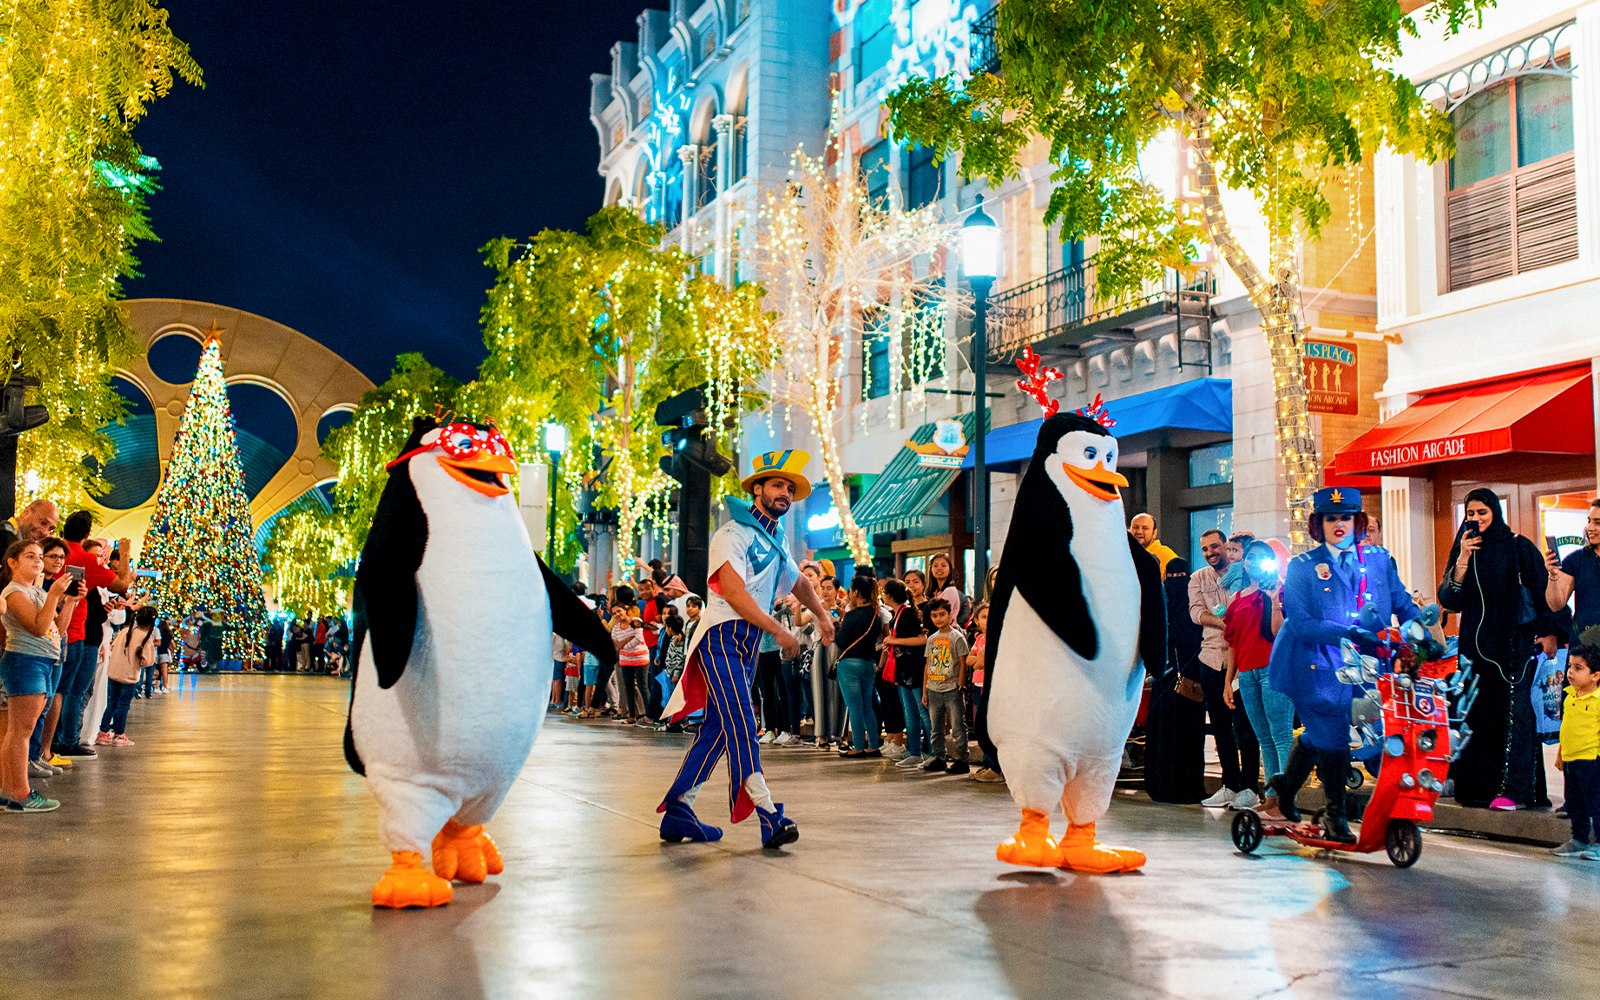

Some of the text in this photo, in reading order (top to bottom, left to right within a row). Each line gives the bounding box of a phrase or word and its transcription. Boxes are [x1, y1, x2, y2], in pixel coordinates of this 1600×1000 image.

[1321, 344, 1351, 365] PLACE
[1371, 438, 1466, 467] FASHION ARCADE
